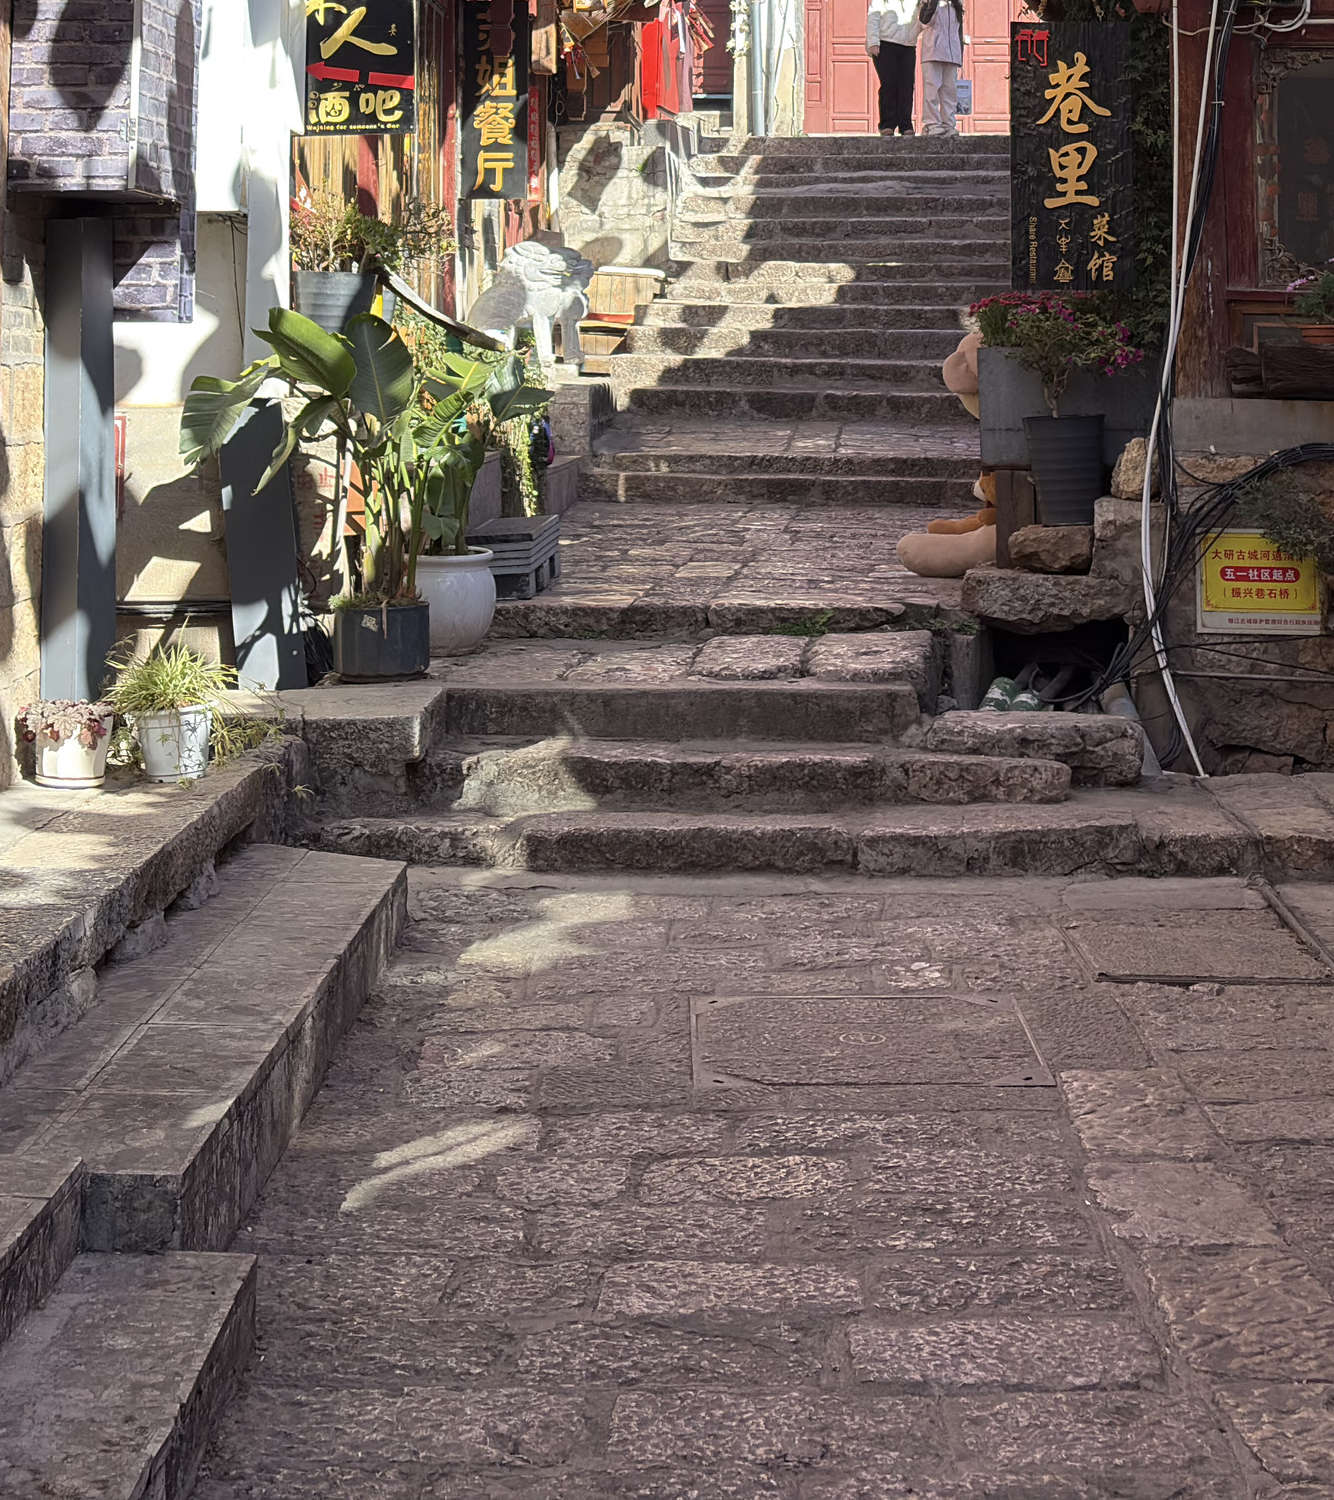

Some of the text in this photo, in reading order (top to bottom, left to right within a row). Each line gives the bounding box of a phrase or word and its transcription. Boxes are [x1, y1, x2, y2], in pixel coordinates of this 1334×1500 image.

[308, 89, 404, 124] 酒吧
[1036, 51, 1112, 209] 巷里
[1028, 216, 1038, 240] Share
[1087, 212, 1118, 283] 菜馆
[1224, 568, 1296, 581] 五一社区起点
